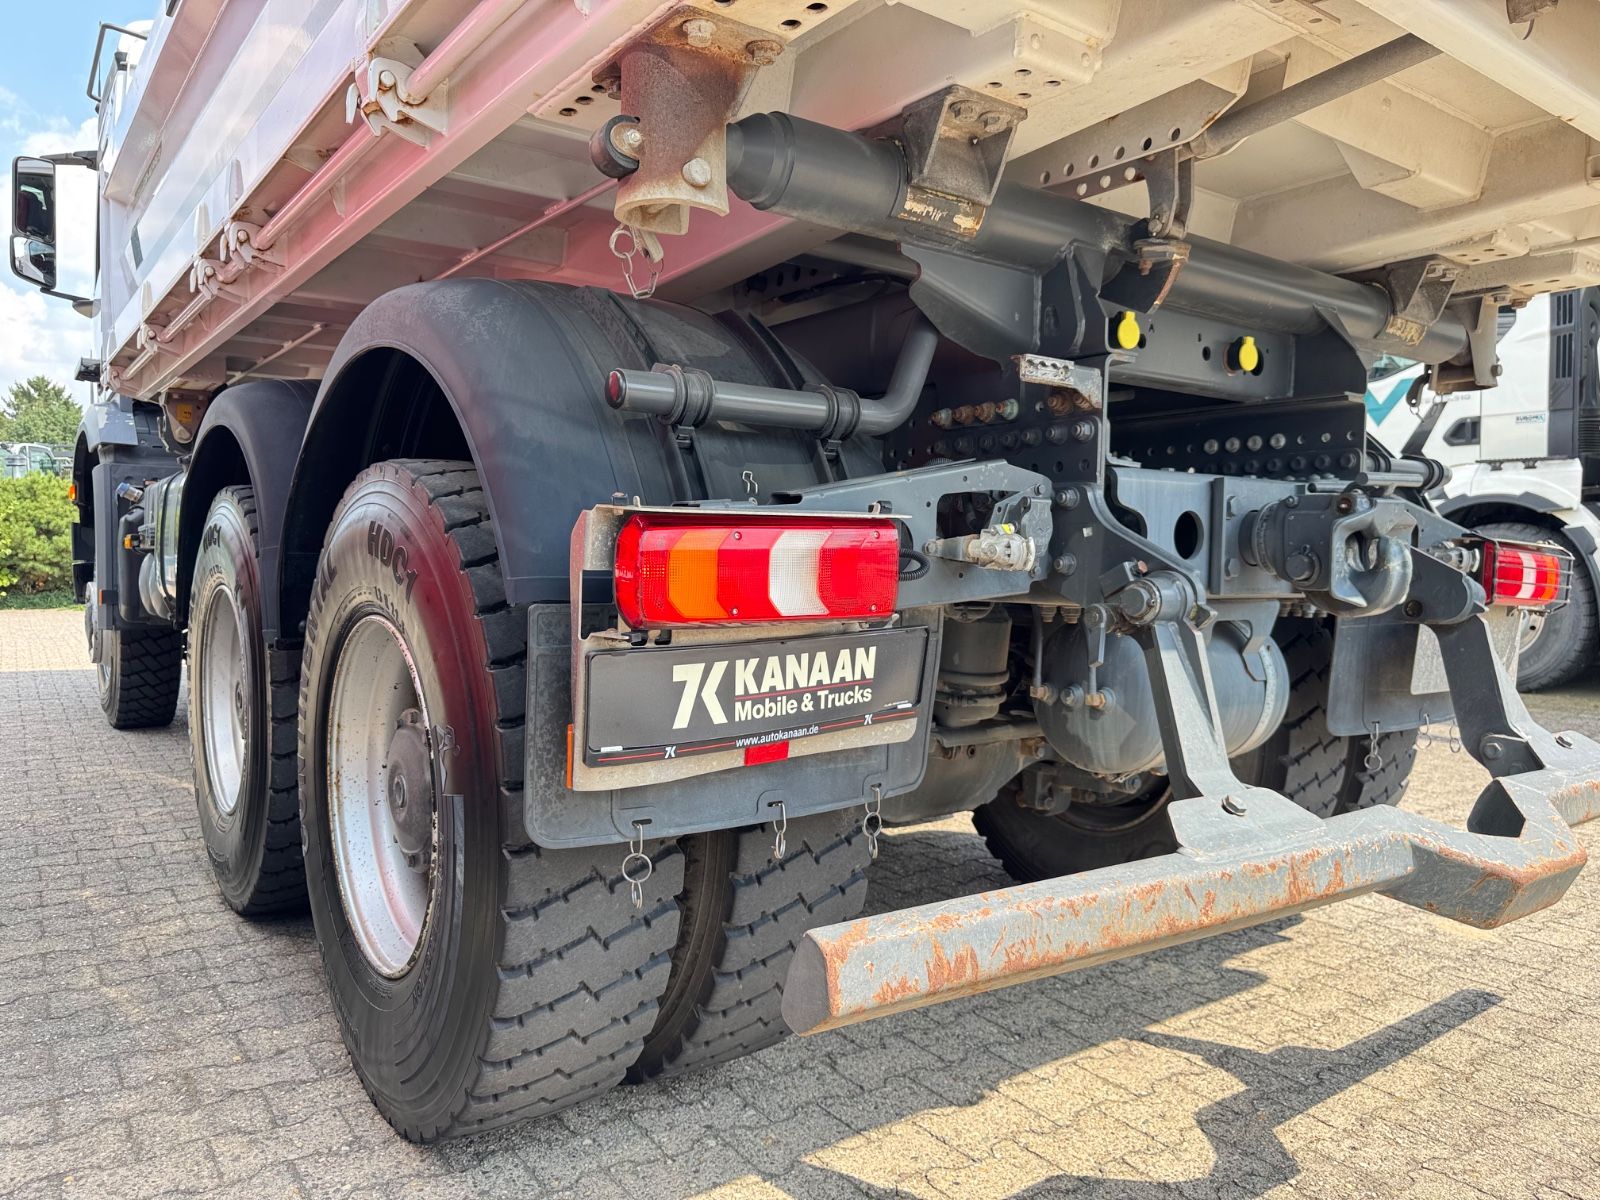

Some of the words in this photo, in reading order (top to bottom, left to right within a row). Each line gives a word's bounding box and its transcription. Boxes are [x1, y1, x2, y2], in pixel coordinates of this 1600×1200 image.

[735, 646, 877, 695] KANAAN
[735, 695, 798, 722] Mobile
[801, 693, 814, 711] &
[817, 686, 872, 710] Trucks
[735, 725, 819, 748] www.autokanaan.de
